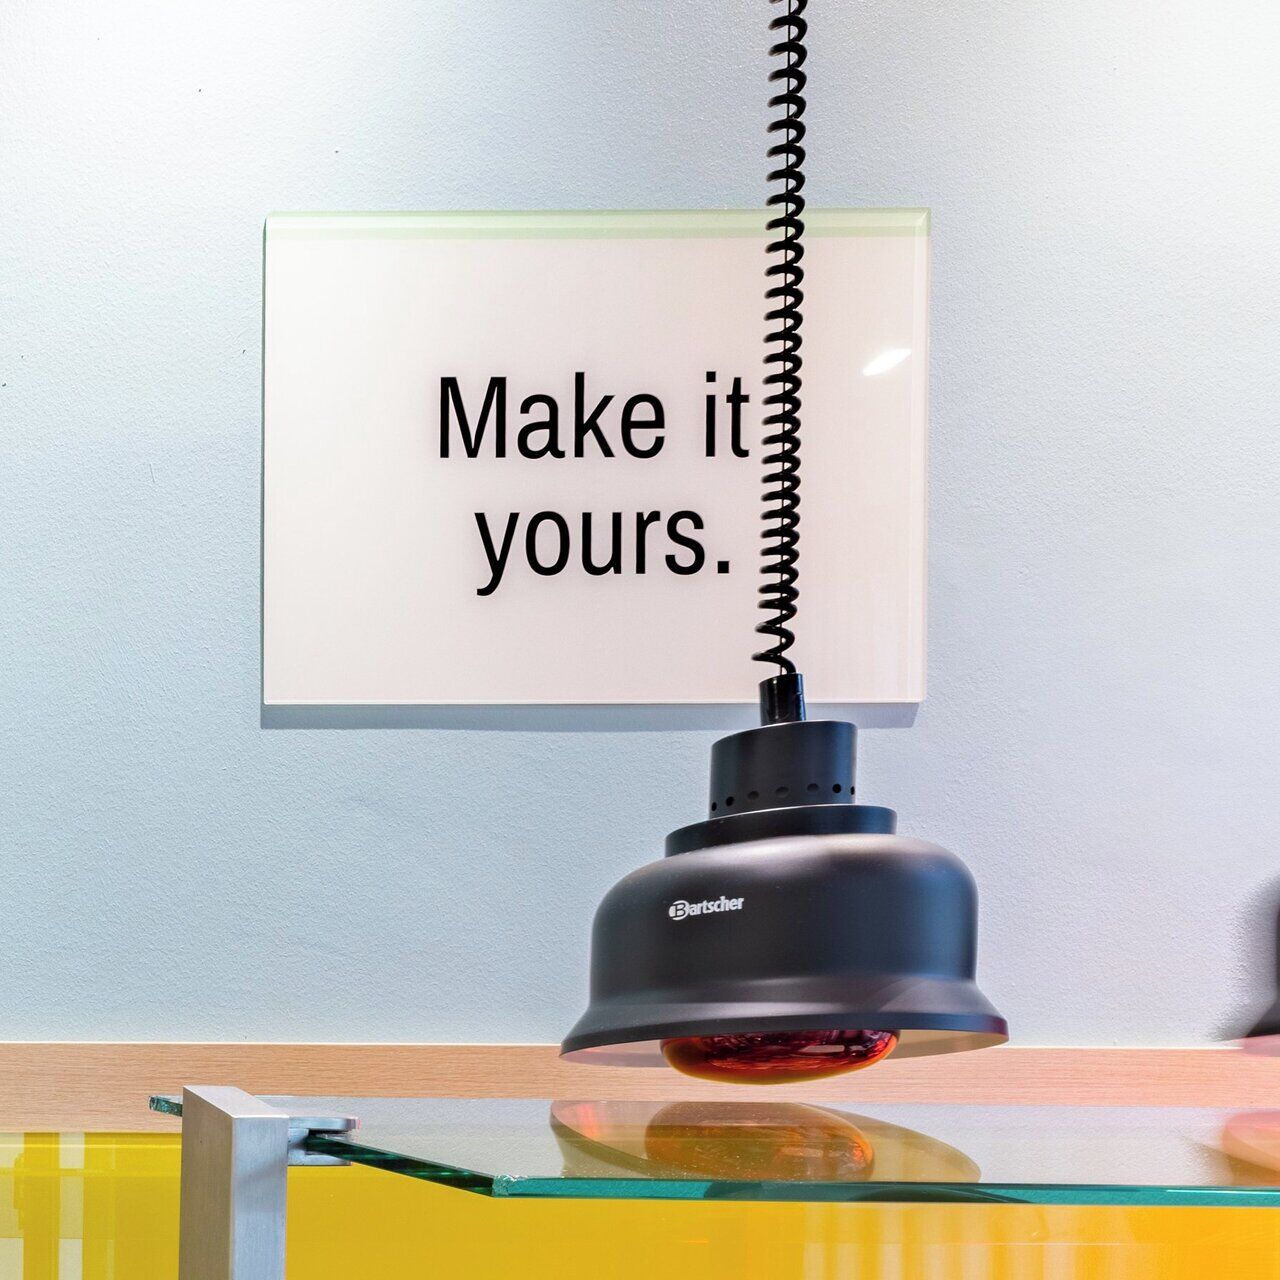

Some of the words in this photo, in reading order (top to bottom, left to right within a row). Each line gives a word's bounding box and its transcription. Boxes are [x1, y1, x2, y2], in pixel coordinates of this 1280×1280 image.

[439, 371, 666, 460] Make
[705, 371, 750, 459] it
[474, 510, 730, 597] yours.
[668, 896, 745, 920] Bartscher
